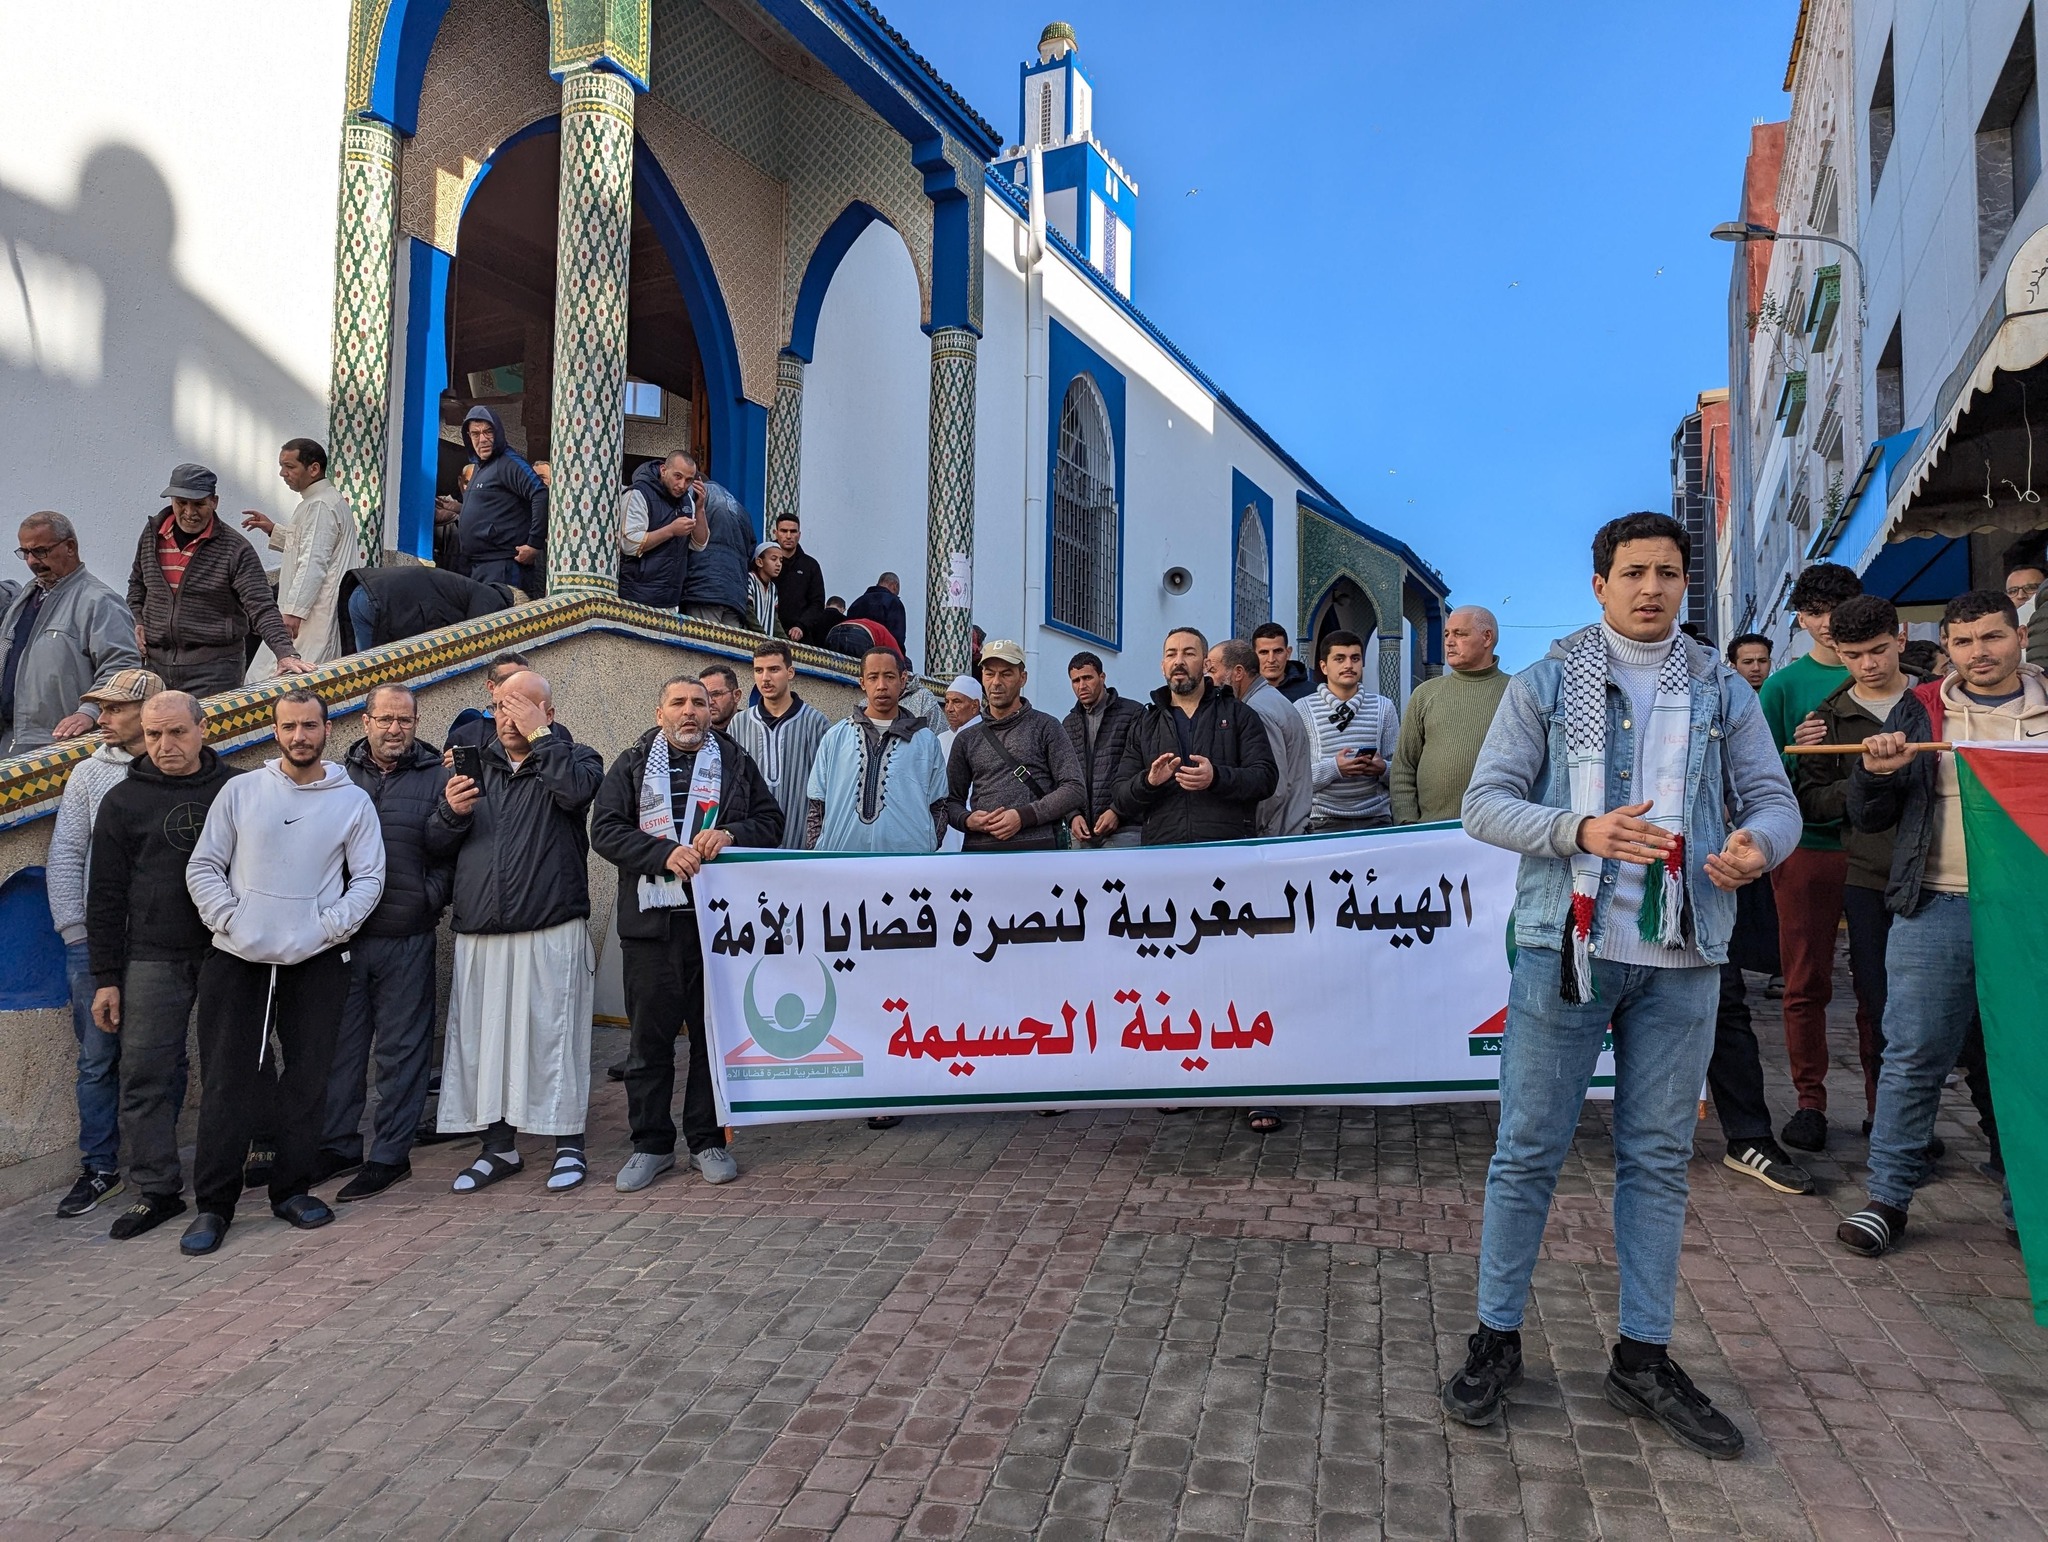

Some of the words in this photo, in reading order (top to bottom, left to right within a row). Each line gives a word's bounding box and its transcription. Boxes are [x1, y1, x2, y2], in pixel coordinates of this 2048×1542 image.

[641, 815, 670, 830] LESTINE
[708, 891, 804, 956] الأمة
[822, 887, 938, 972] قضايا
[950, 884, 1089, 963] لنصرة
[1102, 877, 1315, 959] المغربية
[1330, 869, 1472, 948] الهيئة
[882, 997, 1097, 1077] الحسيمة
[1115, 990, 1274, 1071] مدينة
